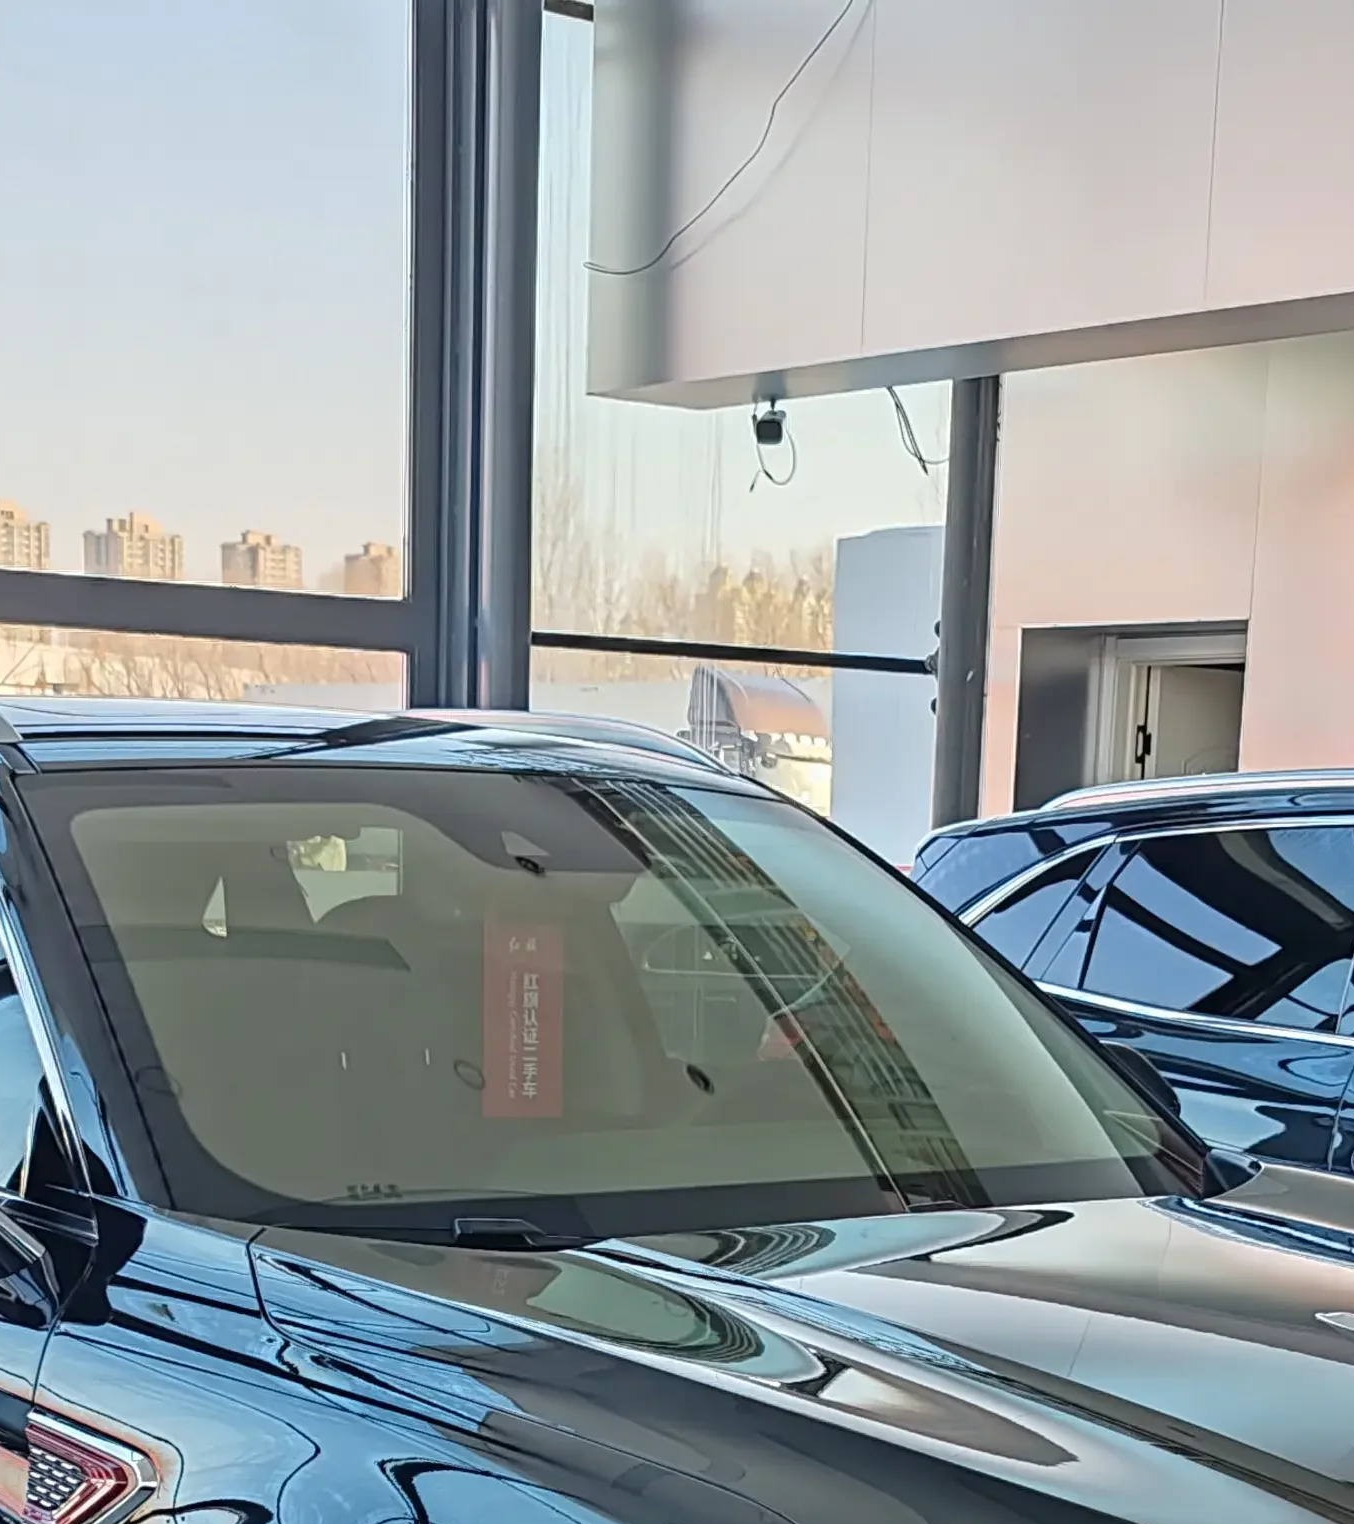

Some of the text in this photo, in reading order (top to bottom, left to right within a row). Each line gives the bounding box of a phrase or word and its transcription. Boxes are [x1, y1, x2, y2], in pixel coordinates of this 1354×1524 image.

[522, 972, 540, 1099] 红旗认证二手车
